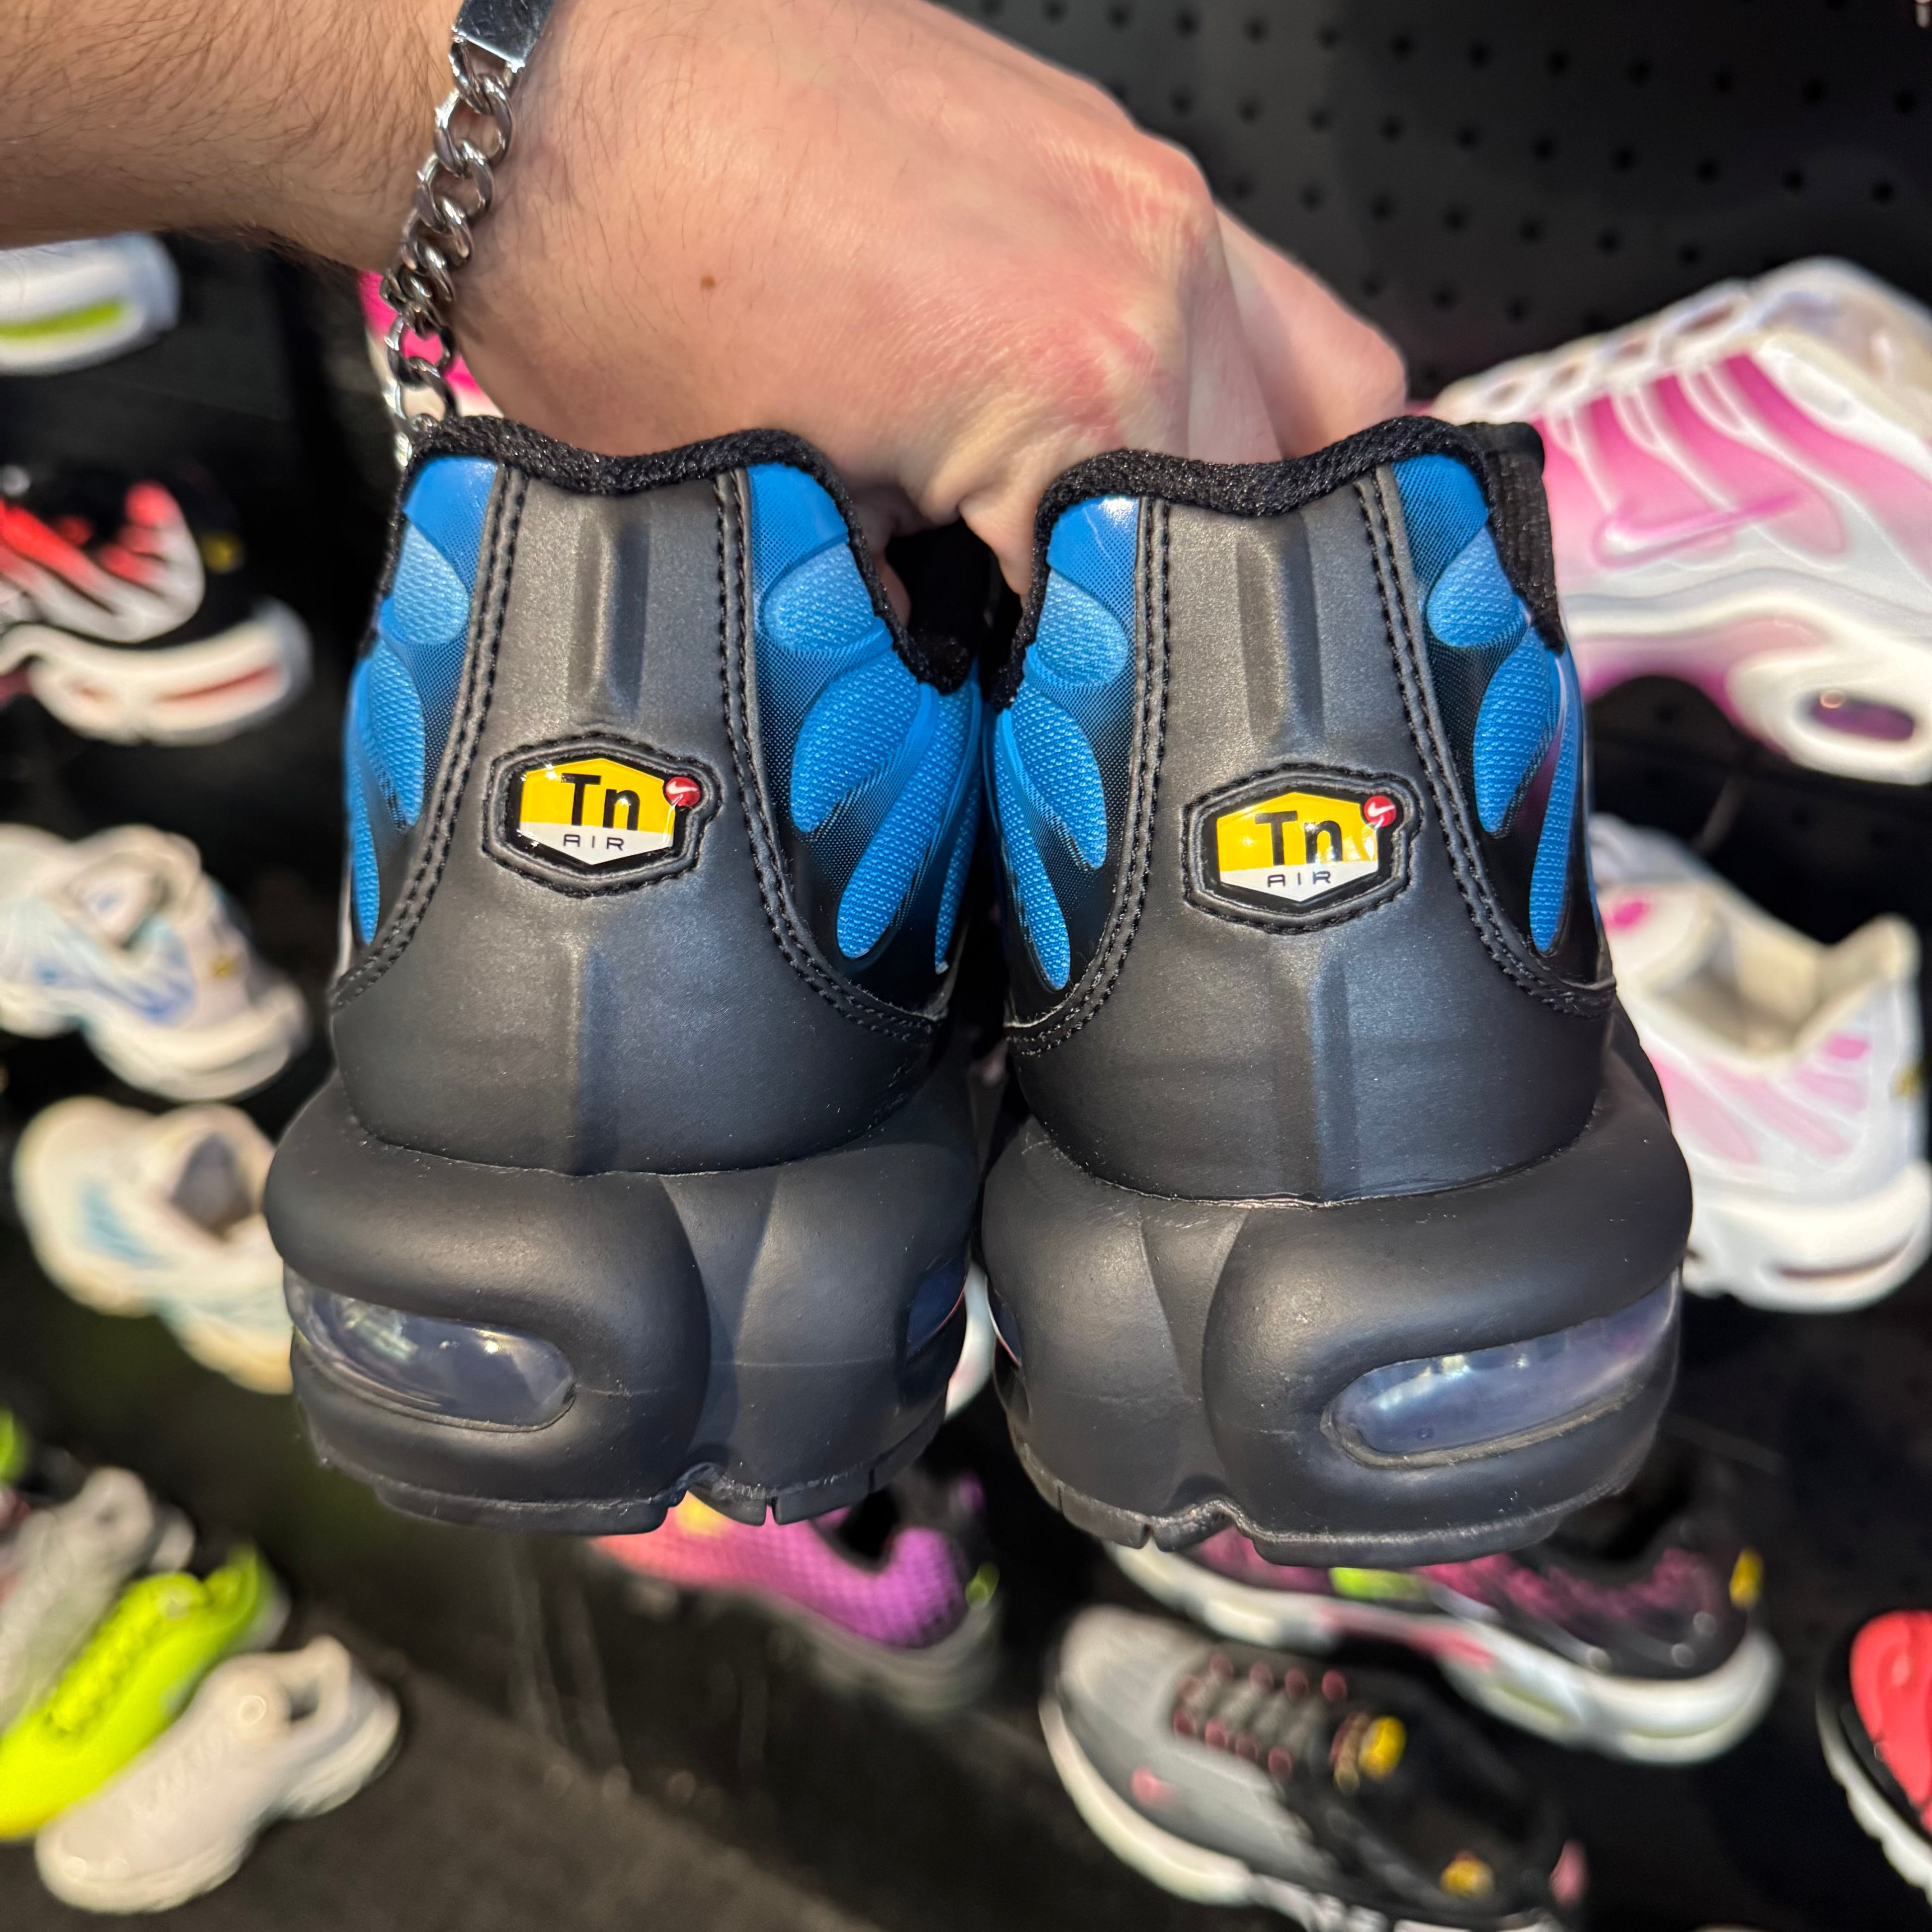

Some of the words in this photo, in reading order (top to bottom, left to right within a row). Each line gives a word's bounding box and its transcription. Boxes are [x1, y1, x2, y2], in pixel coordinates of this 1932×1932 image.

[561, 773, 640, 831] Tn
[563, 834, 624, 851] AIR
[1255, 811, 1343, 866] Tn
[1267, 870, 1332, 888] AIR
